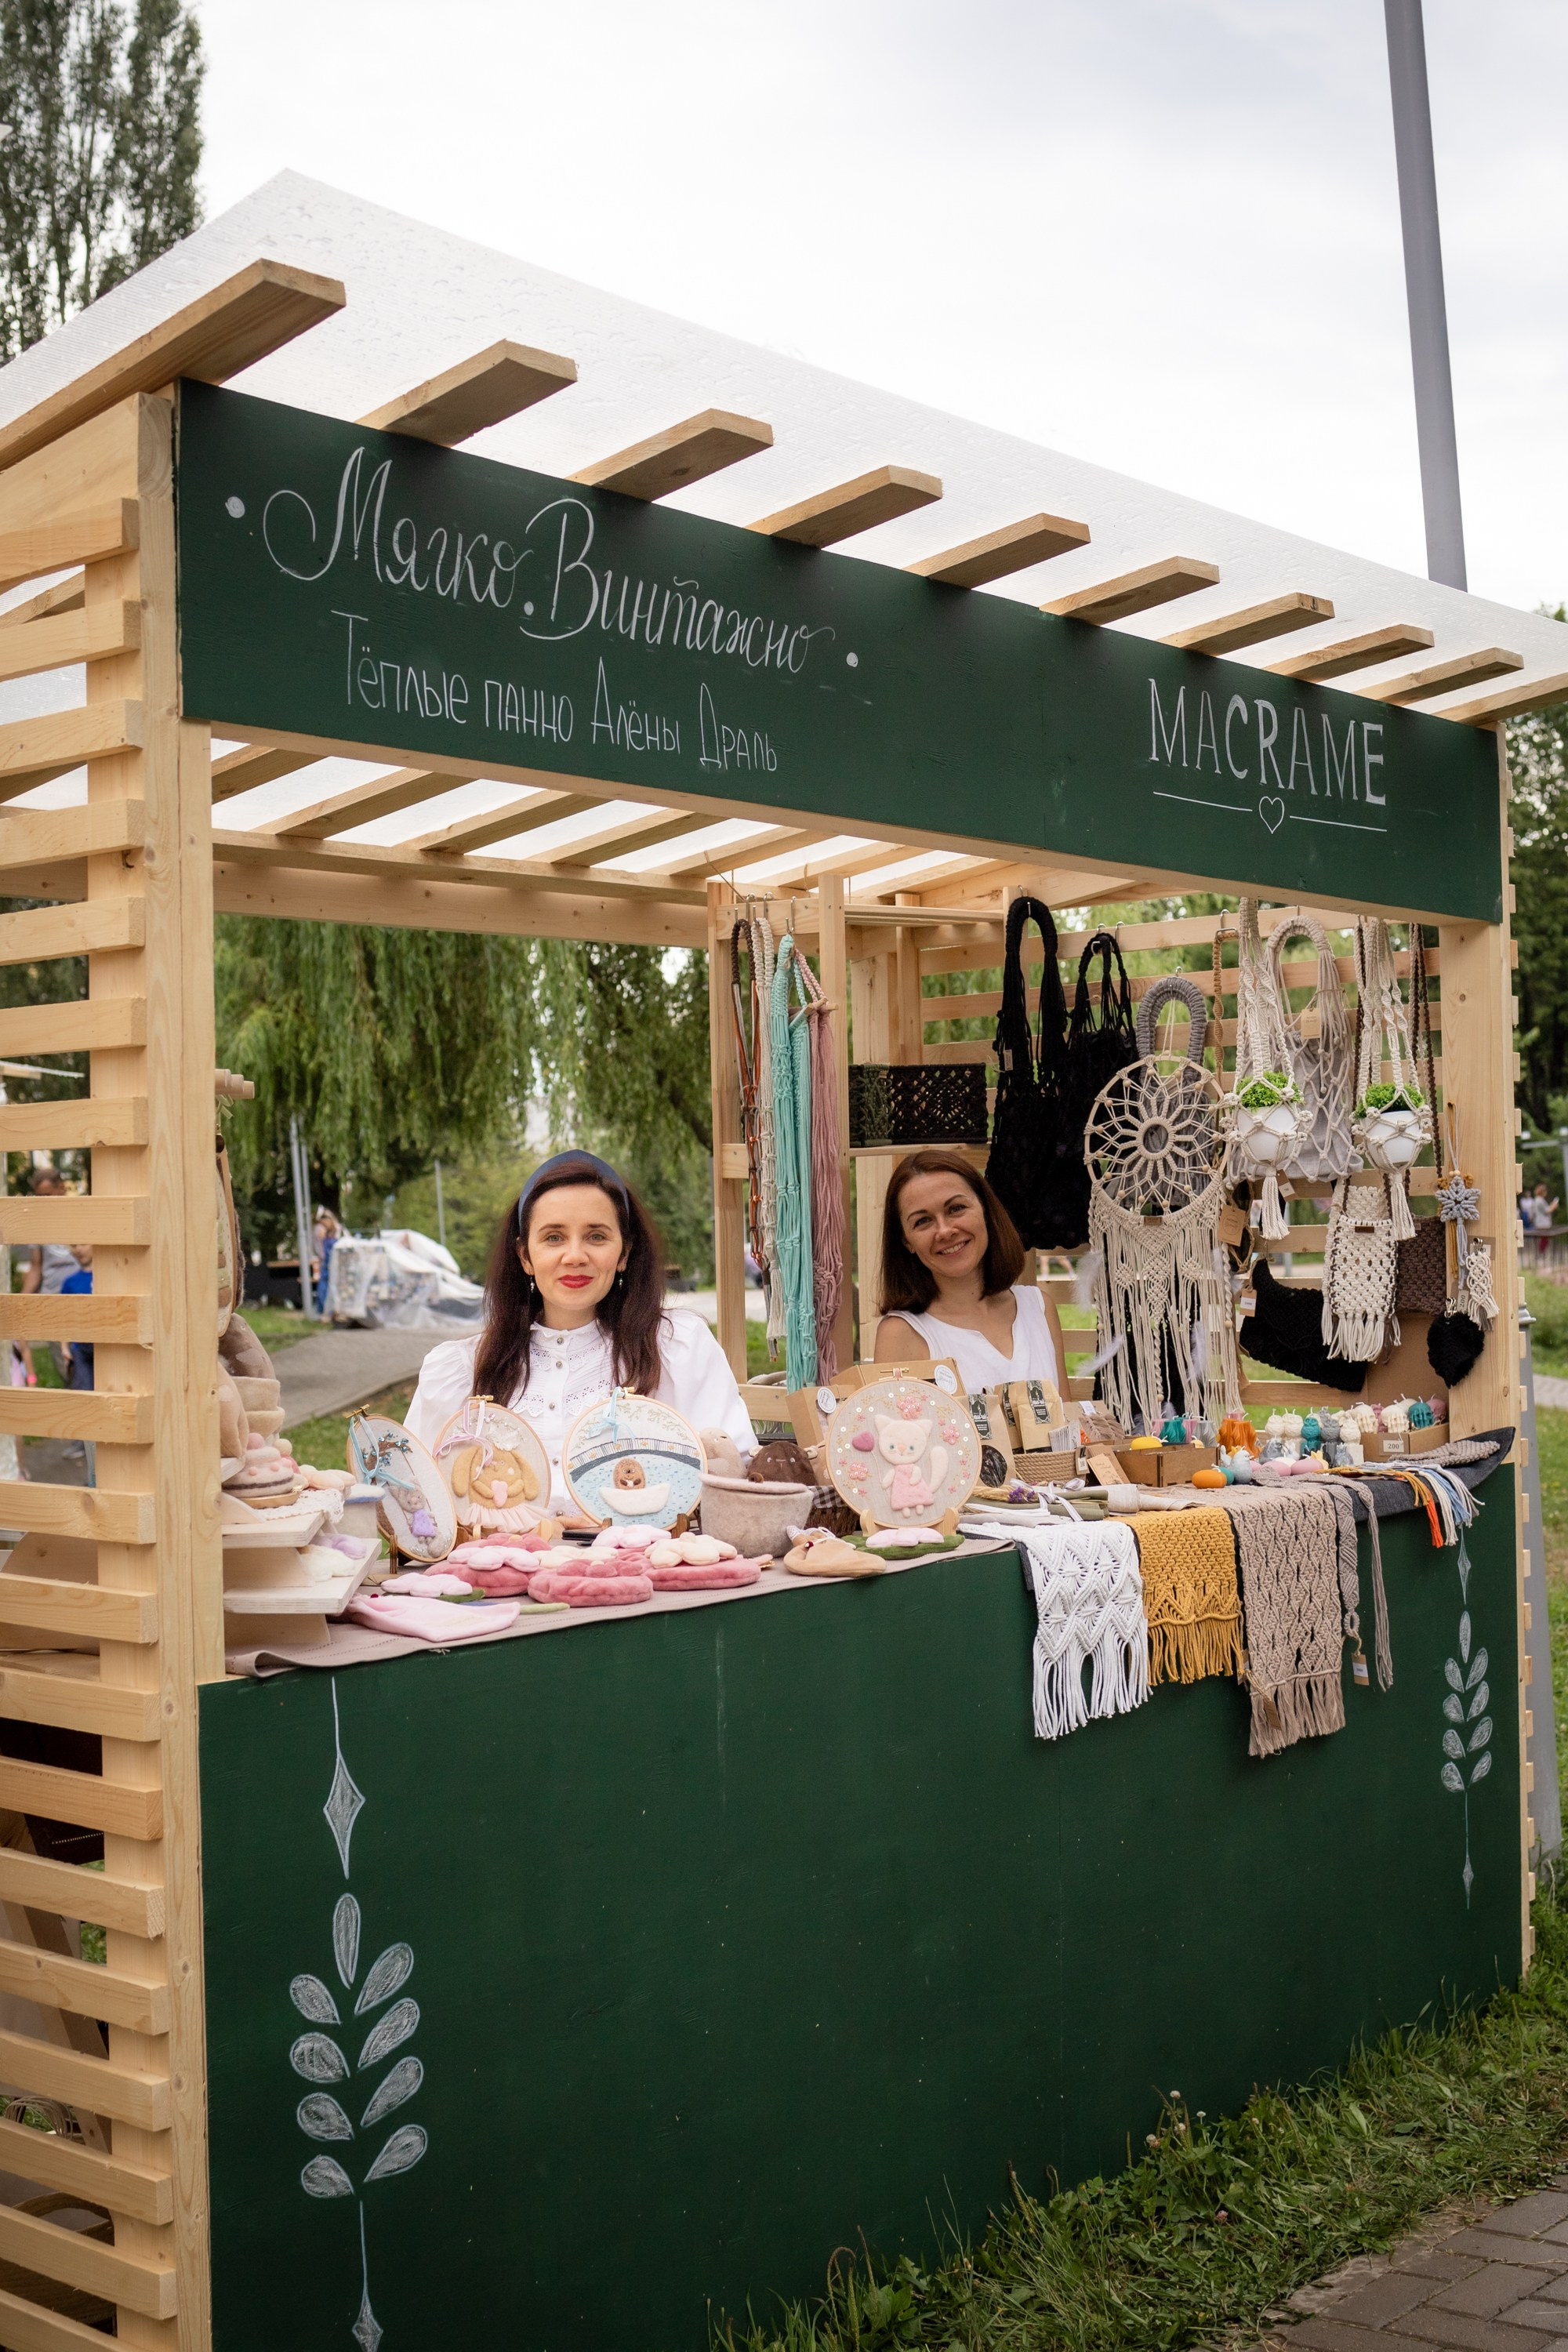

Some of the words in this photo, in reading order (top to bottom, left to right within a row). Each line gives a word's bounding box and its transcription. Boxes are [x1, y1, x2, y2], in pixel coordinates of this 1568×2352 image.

[330, 609, 468, 724] Тёплые
[590, 656, 680, 754] Алёны
[700, 683, 777, 771] Драль
[1149, 678, 1386, 806] MACRAME
